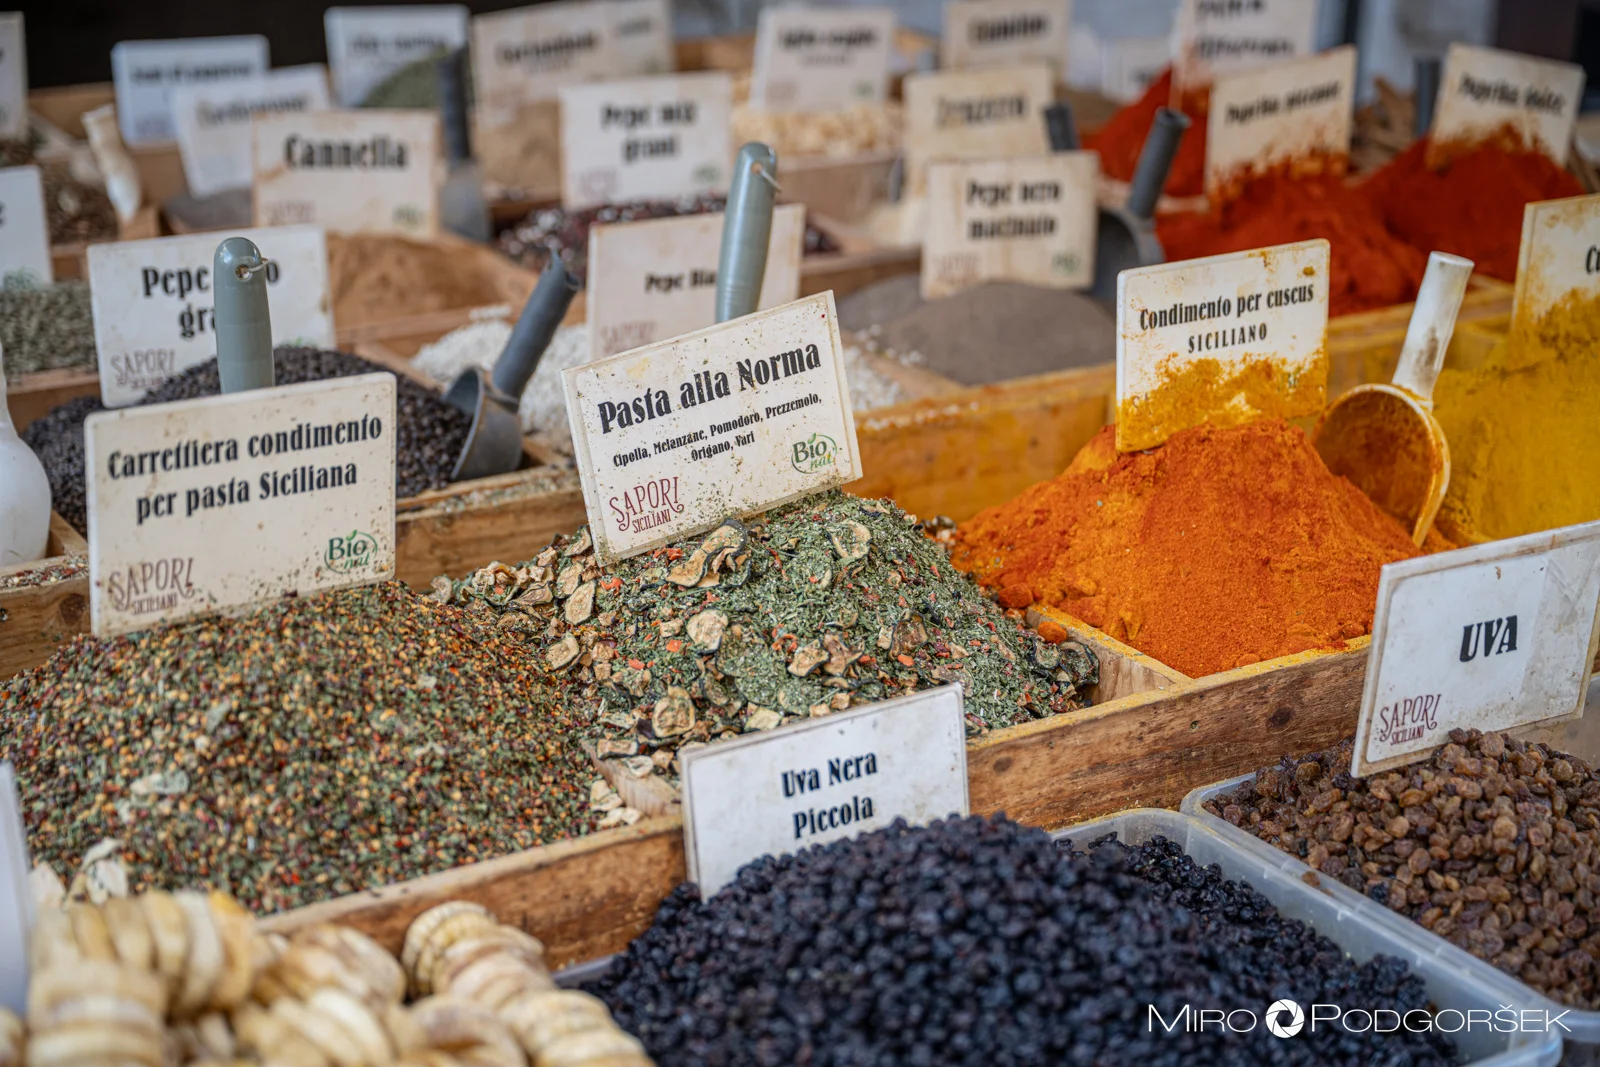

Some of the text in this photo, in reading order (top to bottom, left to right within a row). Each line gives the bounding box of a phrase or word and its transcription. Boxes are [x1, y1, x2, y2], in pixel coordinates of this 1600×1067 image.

[285, 133, 409, 170] Cannella
[142, 265, 209, 298] Pepe
[645, 269, 718, 294] Pepe Bia
[179, 305, 216, 338] gra
[1140, 284, 1314, 331] Condimento per cuscus
[1188, 322, 1268, 354] SICILIANO
[110, 349, 175, 388] SAPORI
[598, 343, 822, 434] Pasta alla Norma
[107, 413, 383, 480] Carrettiera condimento
[613, 391, 822, 468] Cipolla, Melanzane, Pomodoro, Prezzemolo,
[691, 430, 756, 463] Origano, Vari
[792, 436, 828, 465] Bio
[136, 462, 358, 525] per pasta Siciliana
[609, 475, 685, 532] SAPORI
[632, 508, 672, 534] SICILIANI
[328, 535, 368, 562] Bio
[107, 557, 196, 612] SAPORI
[131, 593, 178, 615] SICILIANI
[1459, 614, 1518, 663] UVA
[1379, 693, 1442, 742] SAPORI
[1389, 724, 1425, 746] SICILIANI
[781, 752, 878, 798] Uva Nera
[793, 795, 874, 839] Piccola
